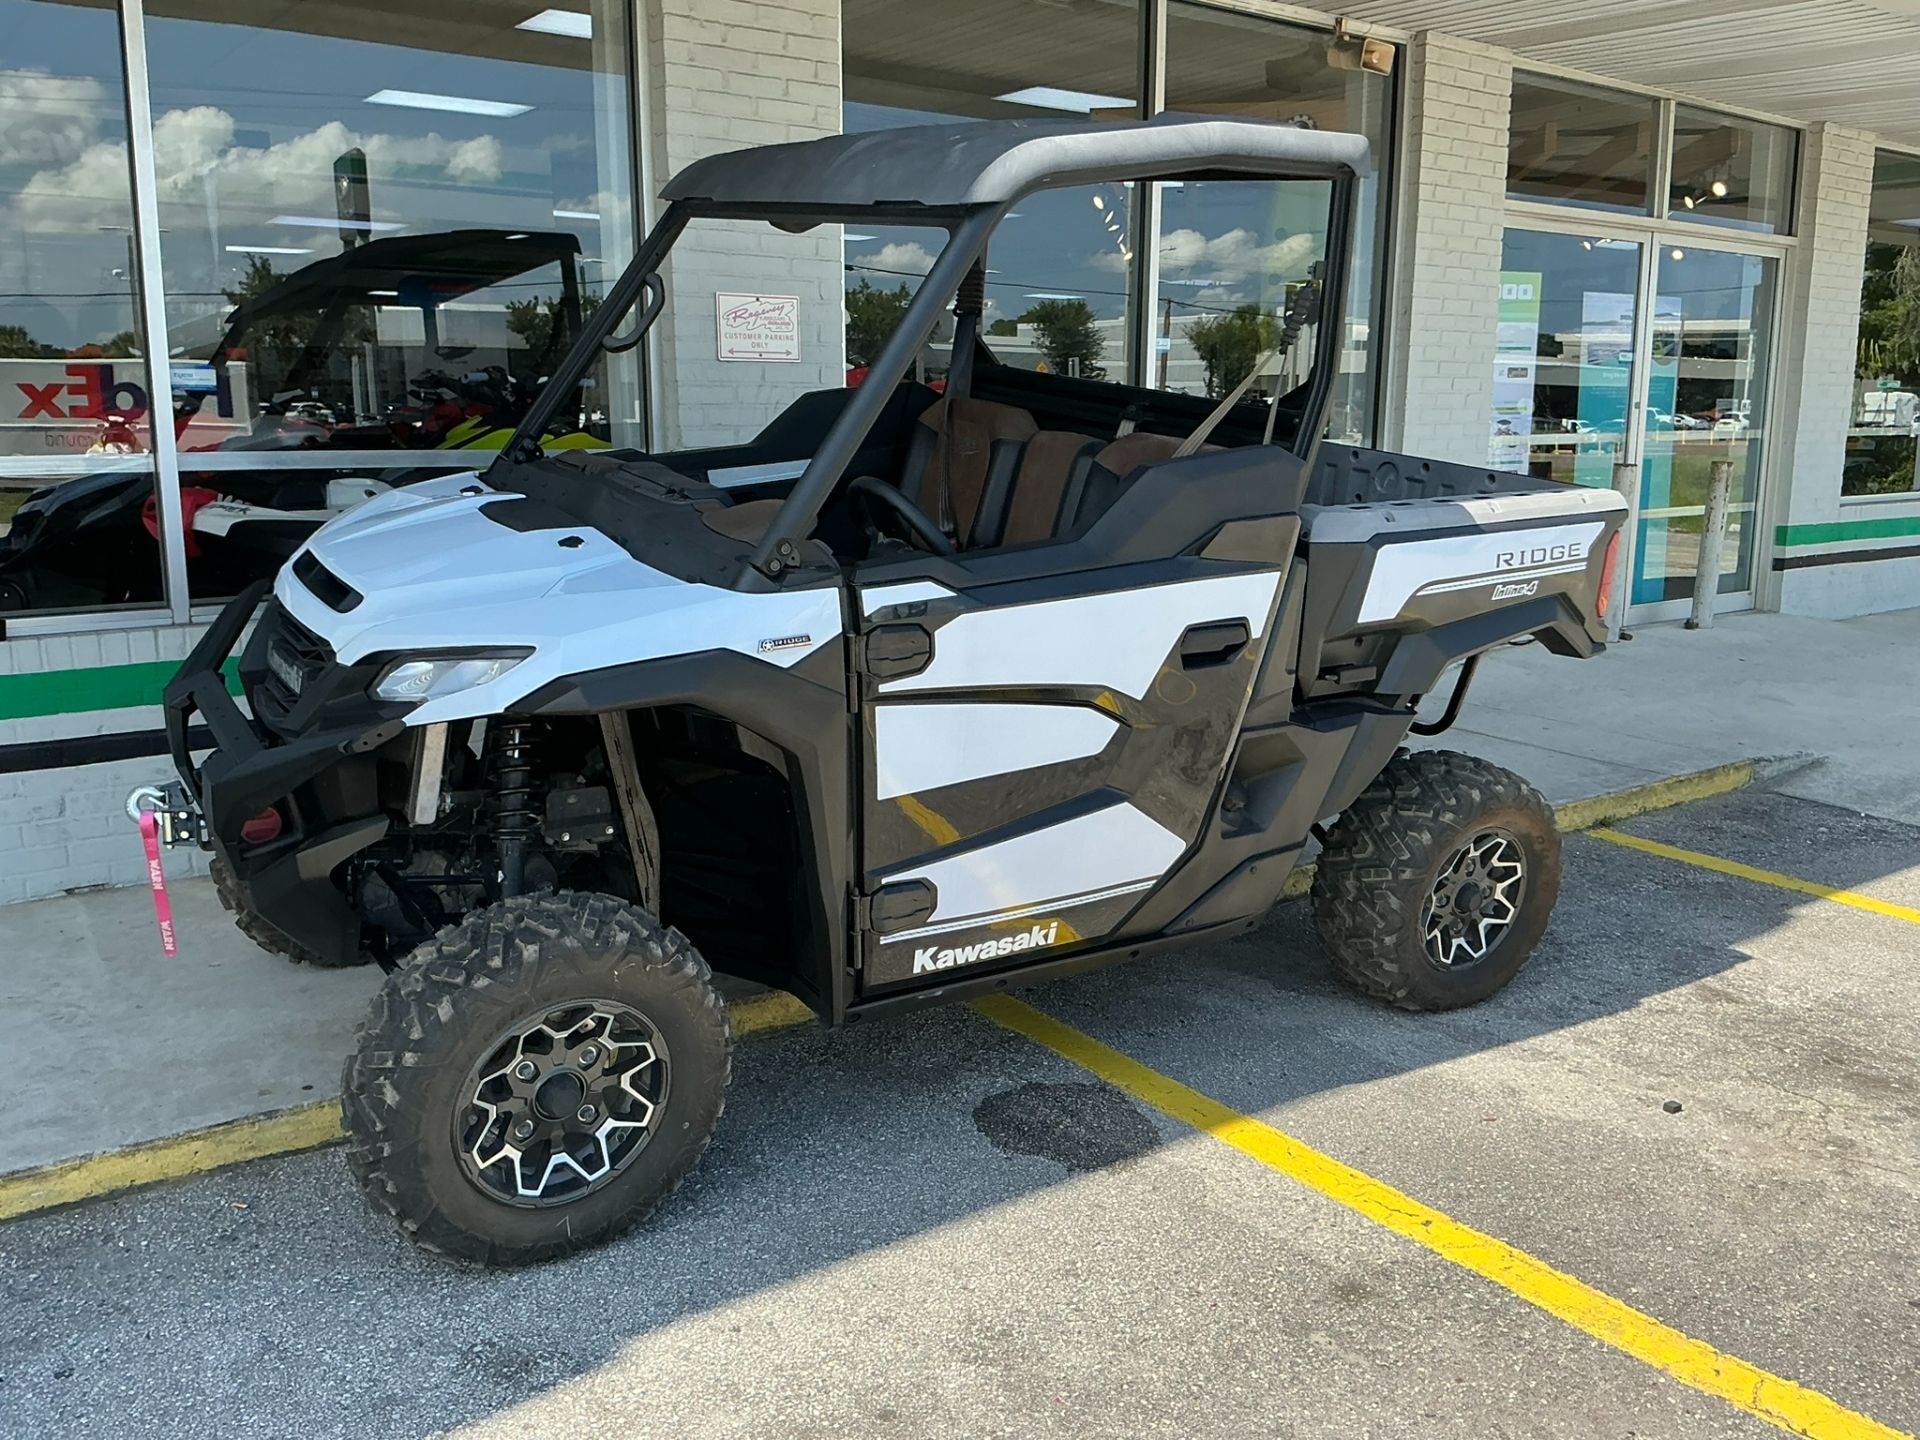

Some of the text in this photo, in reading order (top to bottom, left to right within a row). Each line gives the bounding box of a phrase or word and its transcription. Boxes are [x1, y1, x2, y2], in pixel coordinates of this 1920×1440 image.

[726, 304, 785, 327] Regency
[724, 332, 795, 341] CUSTOMER PARKING
[751, 341, 769, 349] ONLY
[1496, 543, 1582, 568] RIDGE
[774, 636, 810, 646] RIDGE
[149, 859, 164, 890] WARN
[160, 920, 175, 951] WARN
[912, 921, 1058, 974] Kawasaki
